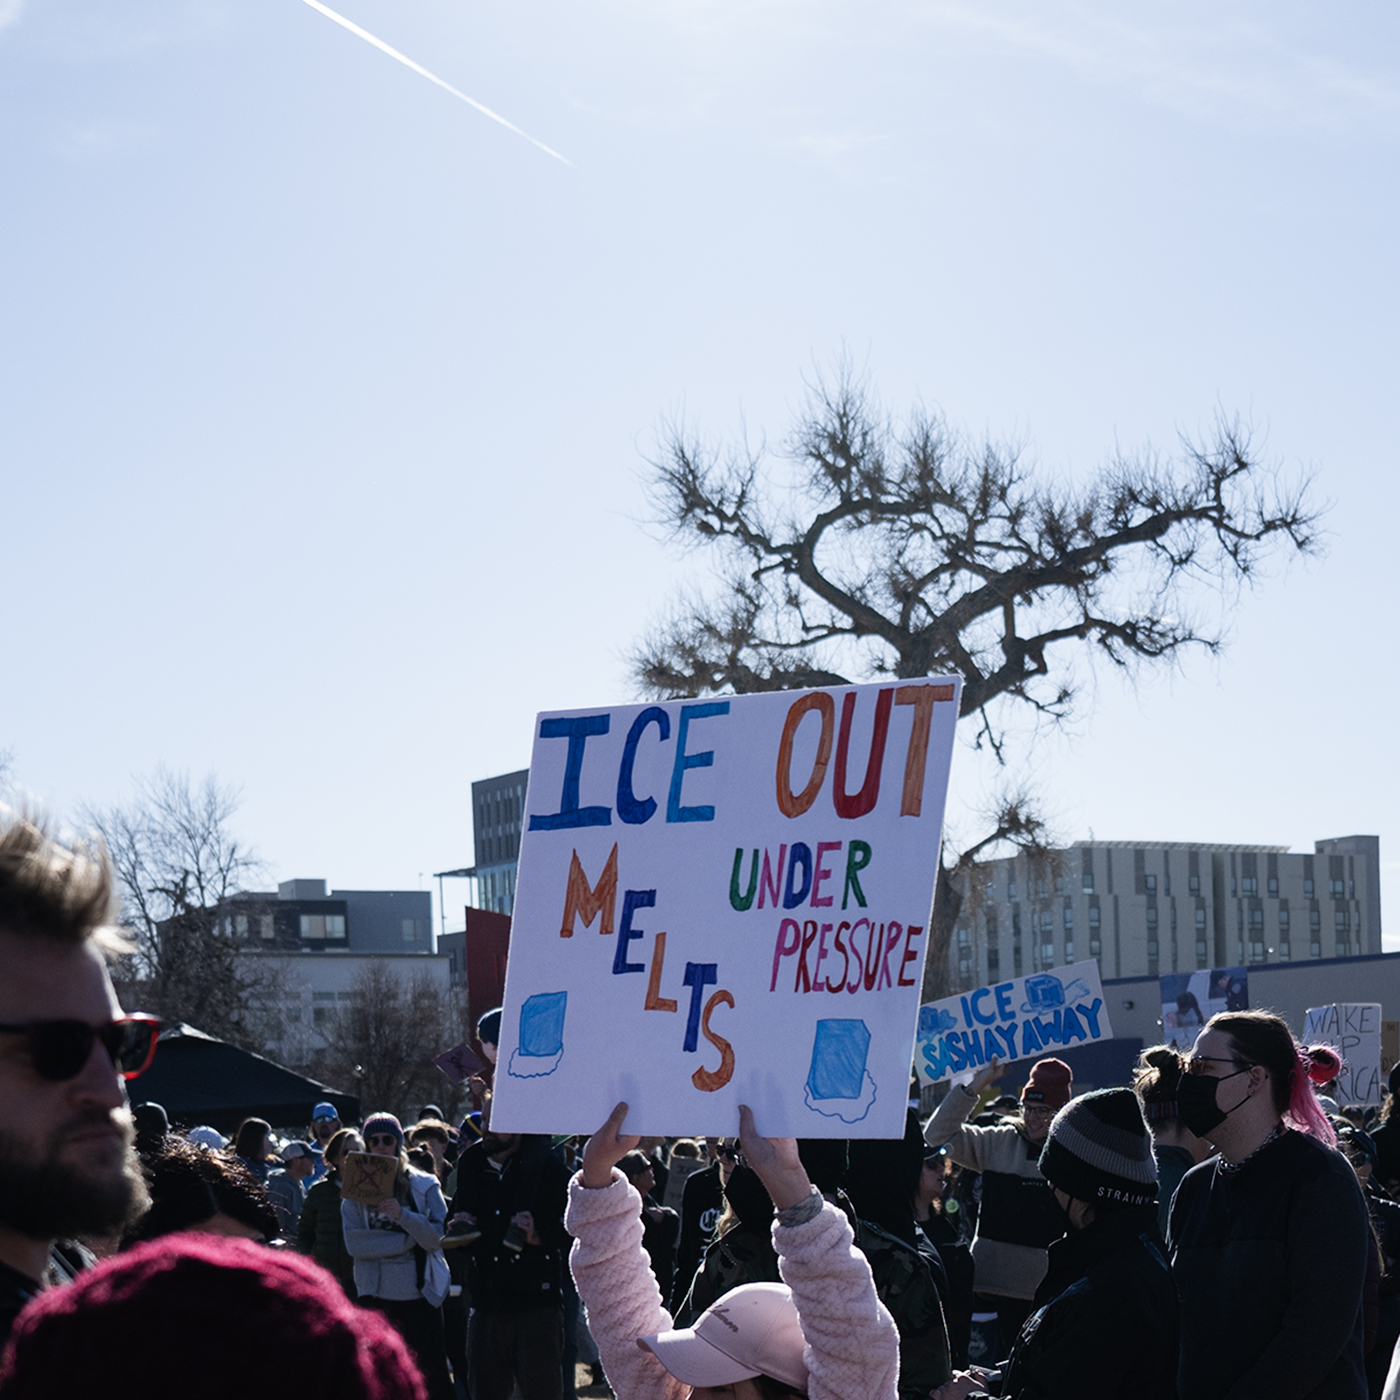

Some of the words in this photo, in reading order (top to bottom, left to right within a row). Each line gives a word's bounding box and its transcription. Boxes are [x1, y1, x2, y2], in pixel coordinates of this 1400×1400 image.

[527, 701, 731, 831] ICE
[776, 683, 956, 820] OUT
[728, 840, 872, 912] UNDER
[559, 841, 735, 1093] MELTS
[769, 918, 924, 994] PRESSURE
[922, 1022, 1019, 1081] SASHAY
[1022, 998, 1103, 1055] AWAY
[960, 983, 1016, 1028] ICE
[1308, 1006, 1375, 1035] WAKE
[1331, 1035, 1361, 1059] P
